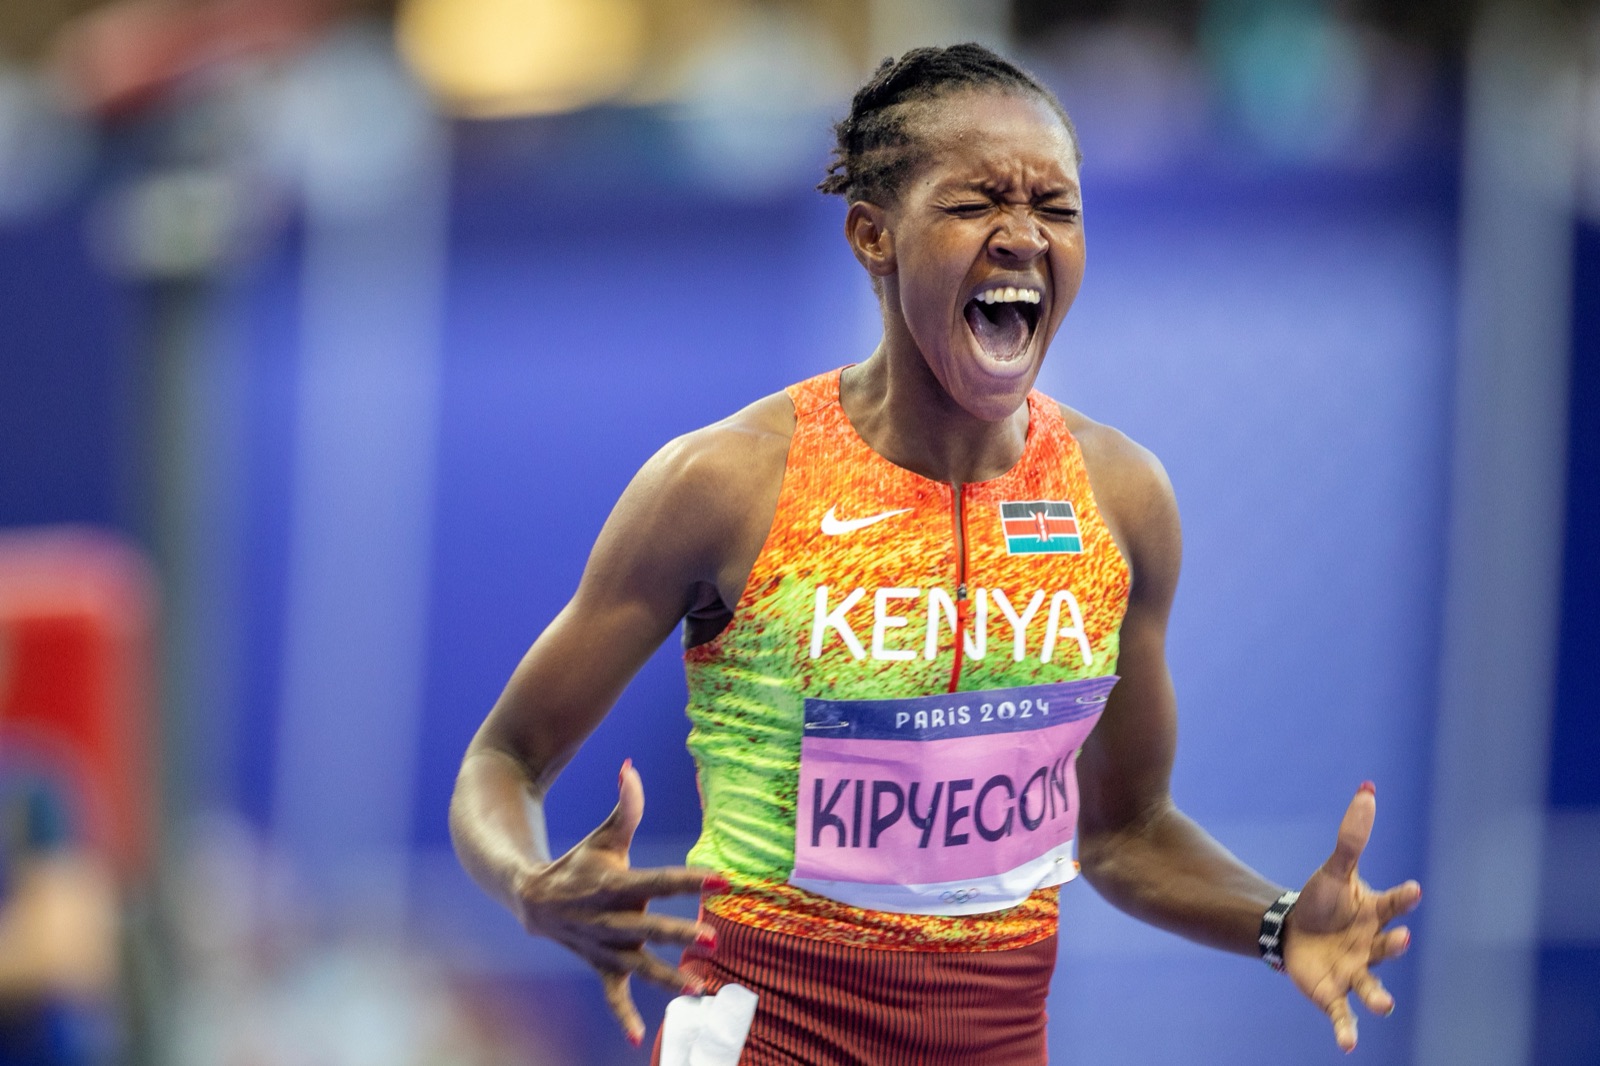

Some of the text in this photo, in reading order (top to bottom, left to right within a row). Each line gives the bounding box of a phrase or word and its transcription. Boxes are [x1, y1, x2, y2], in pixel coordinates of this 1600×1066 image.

[810, 585, 1093, 666] KENYA
[980, 698, 1050, 722] 2024
[810, 750, 1073, 848] KIPYEGON
